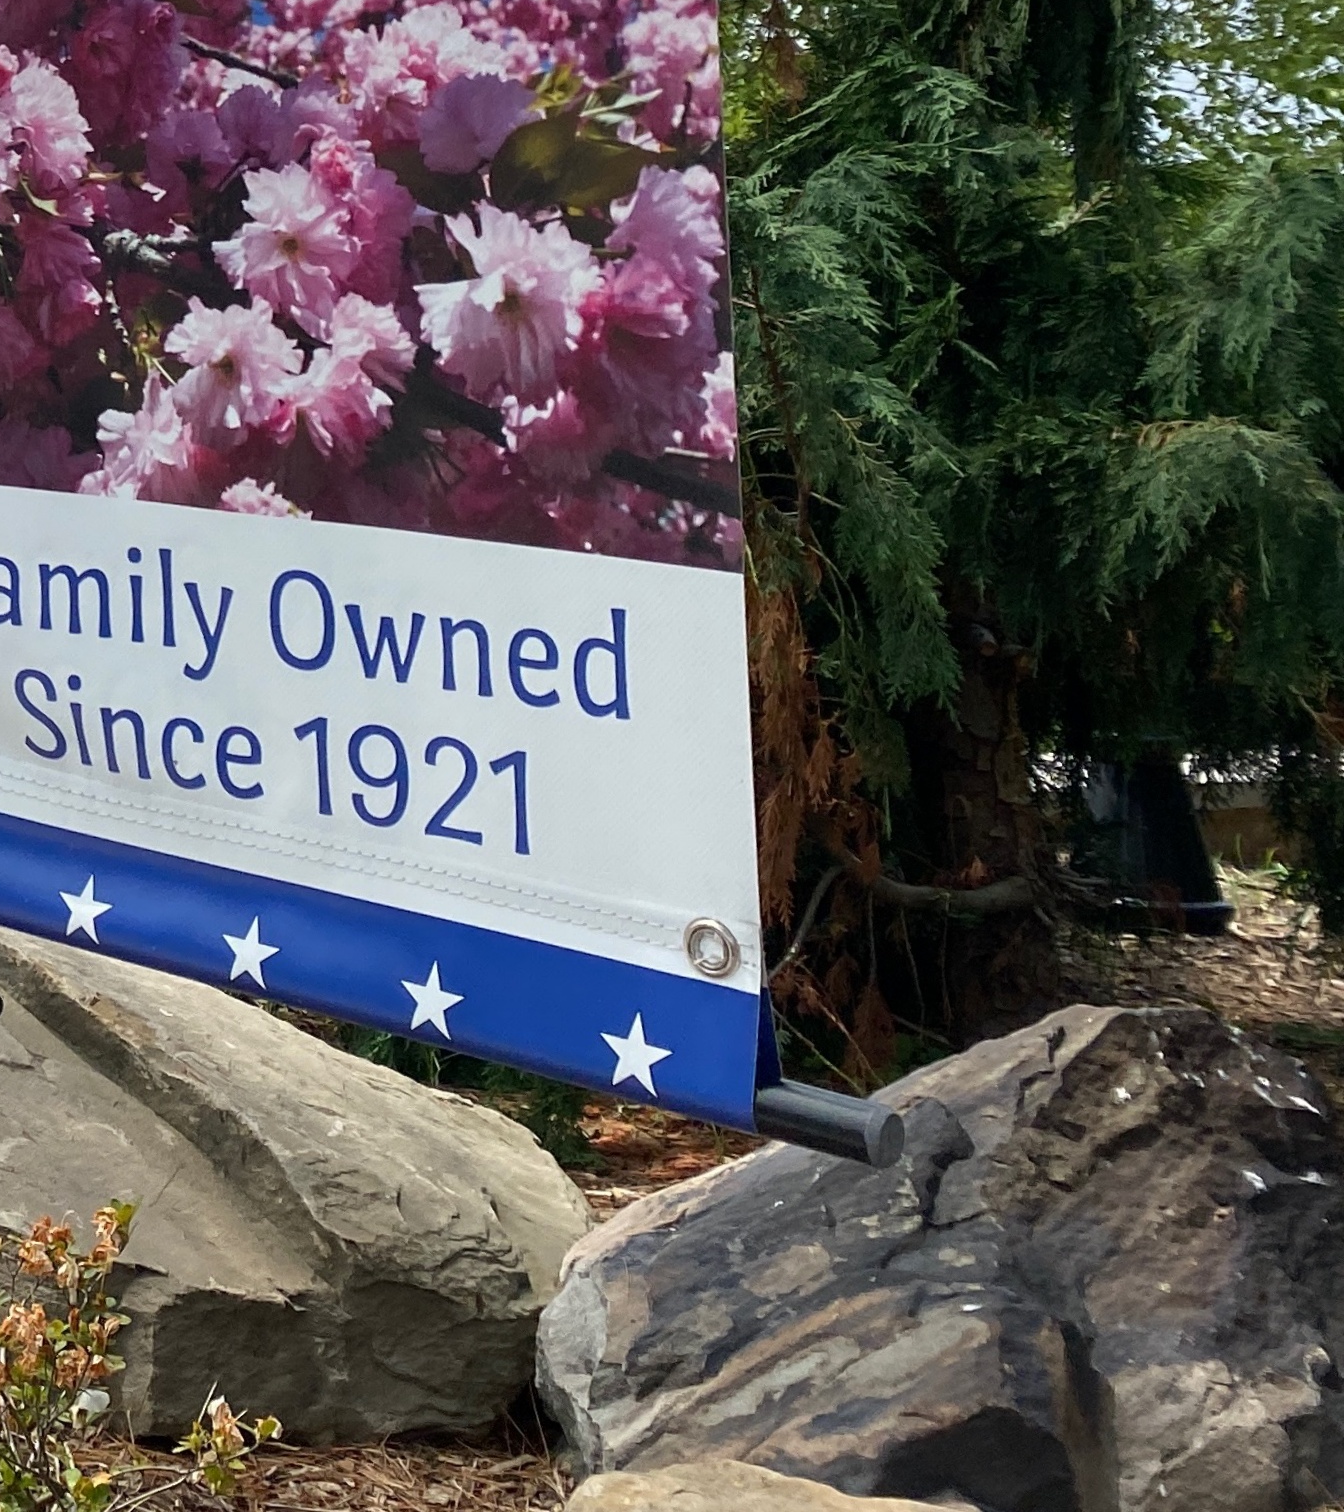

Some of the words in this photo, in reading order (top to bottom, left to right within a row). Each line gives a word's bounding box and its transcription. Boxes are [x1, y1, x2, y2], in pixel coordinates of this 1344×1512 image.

[270, 570, 630, 720] Owned
[16, 670, 264, 799] Since
[295, 717, 529, 855] 1921
